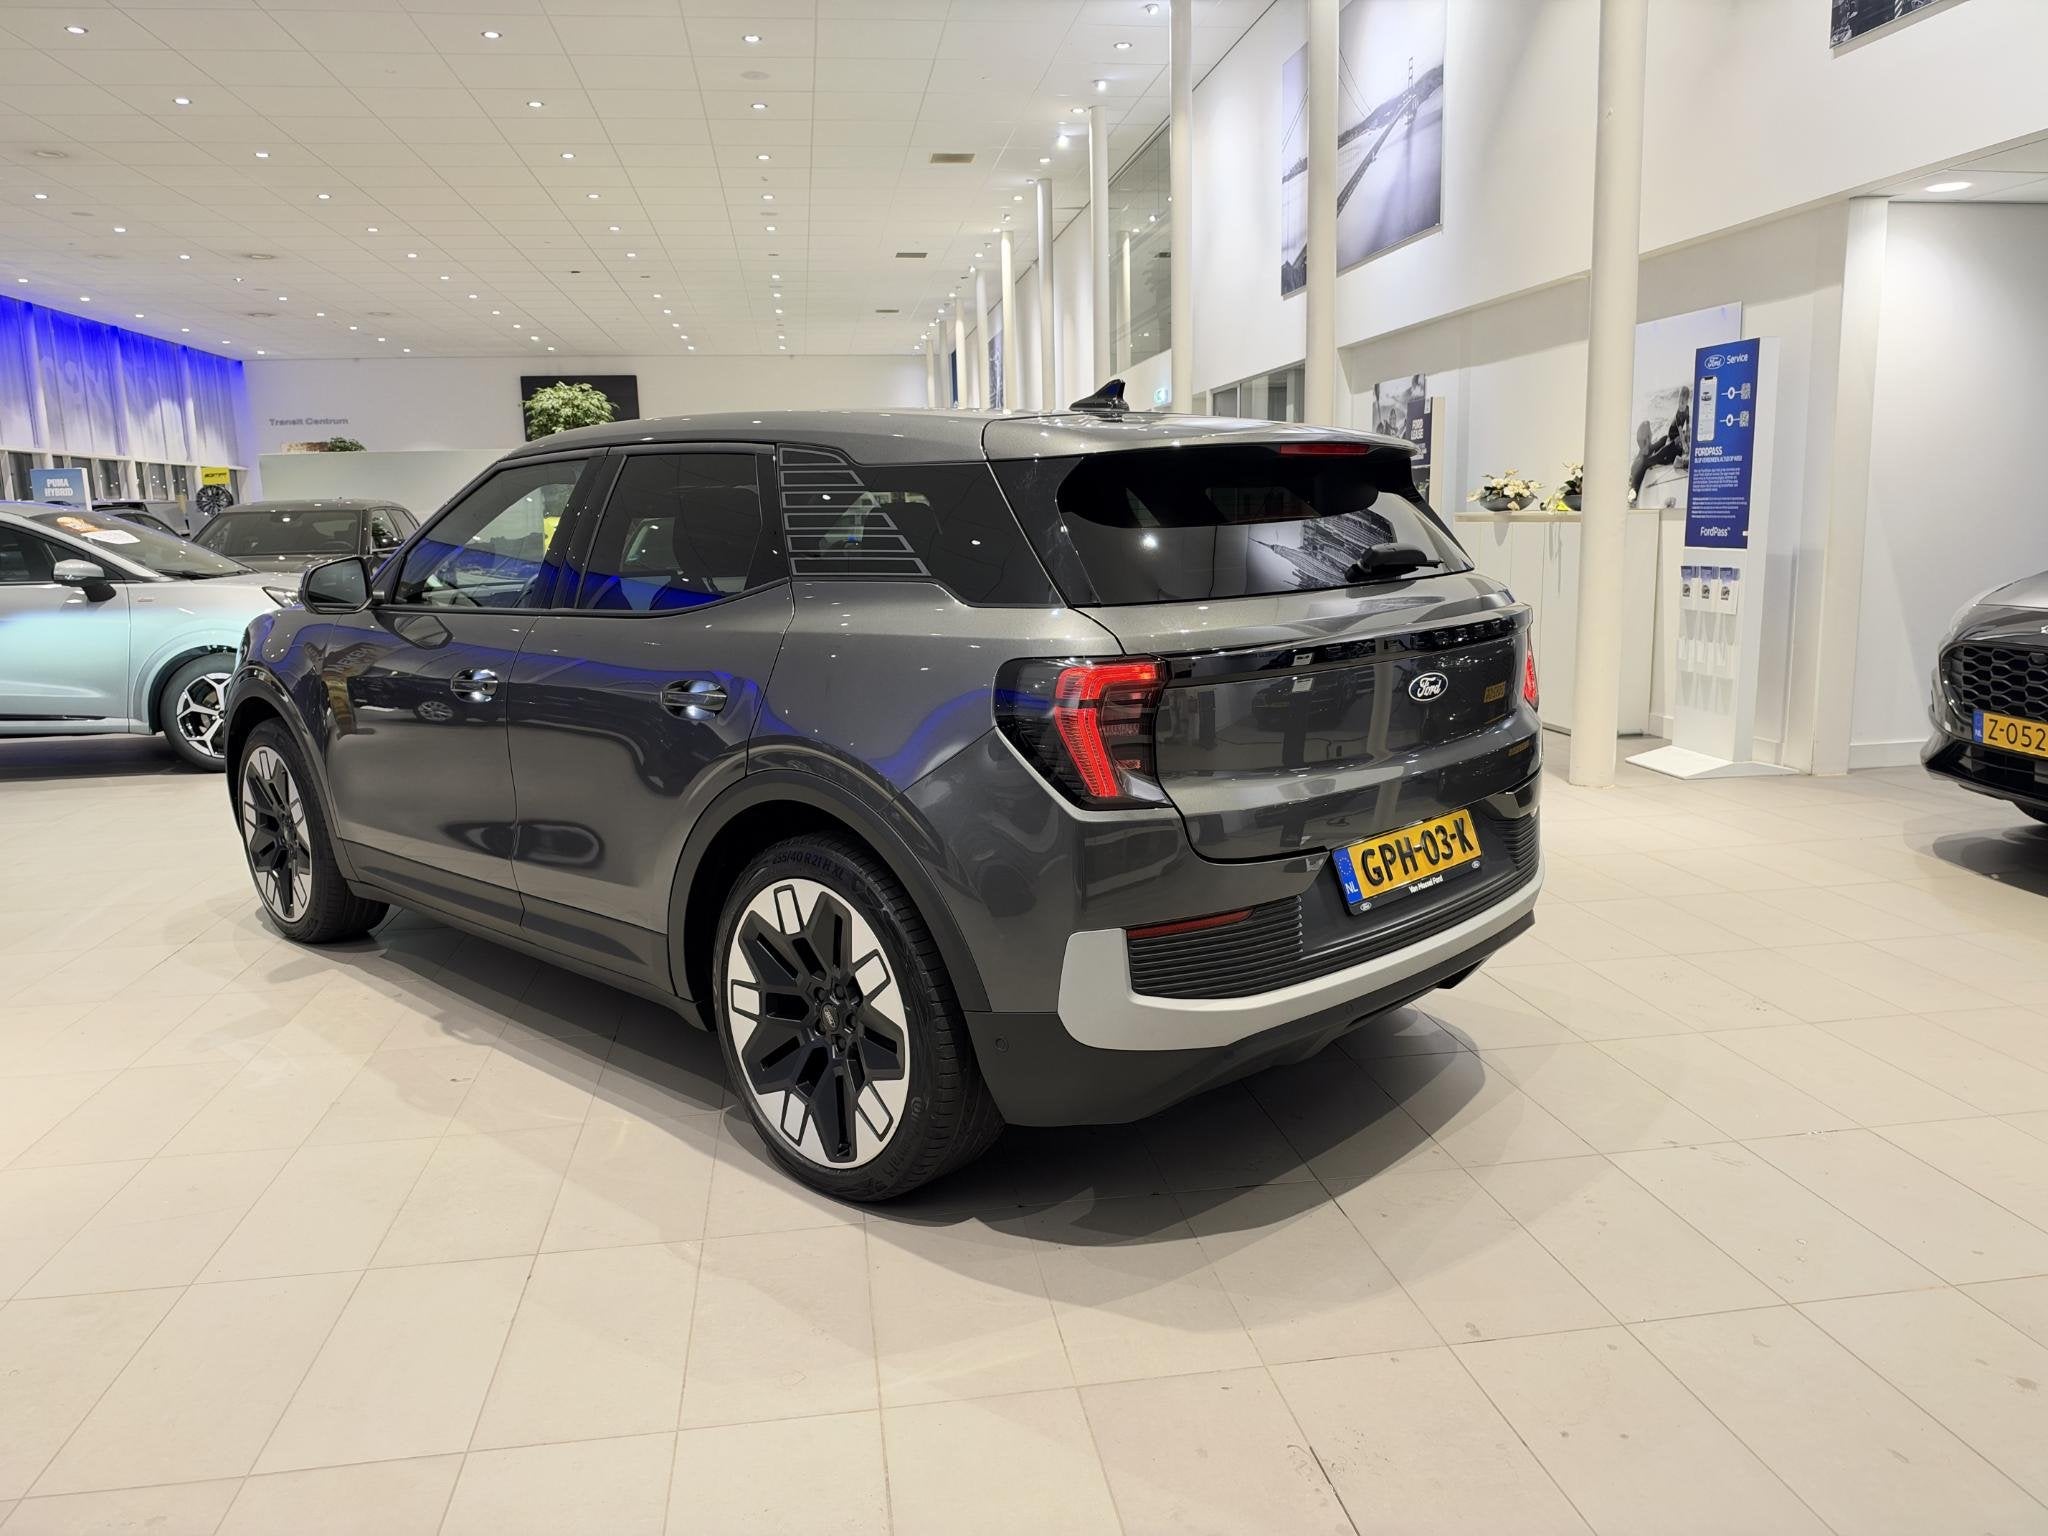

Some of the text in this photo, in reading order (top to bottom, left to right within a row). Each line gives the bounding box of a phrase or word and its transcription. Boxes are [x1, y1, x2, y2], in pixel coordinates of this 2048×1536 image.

[1726, 353, 1749, 364] Service
[269, 417, 349, 426] Transit Centrum
[1694, 446, 1723, 456] FORDPASS
[46, 478, 70, 488] PUMA
[44, 487, 74, 497] HYBRID
[1415, 675, 1442, 698] Ford
[1988, 718, 2046, 752] Z-052
[1361, 817, 1474, 886] GPH-03-K
[1345, 881, 1359, 894] NL
[1408, 885, 1419, 893] Van
[1432, 874, 1444, 885] Ford
